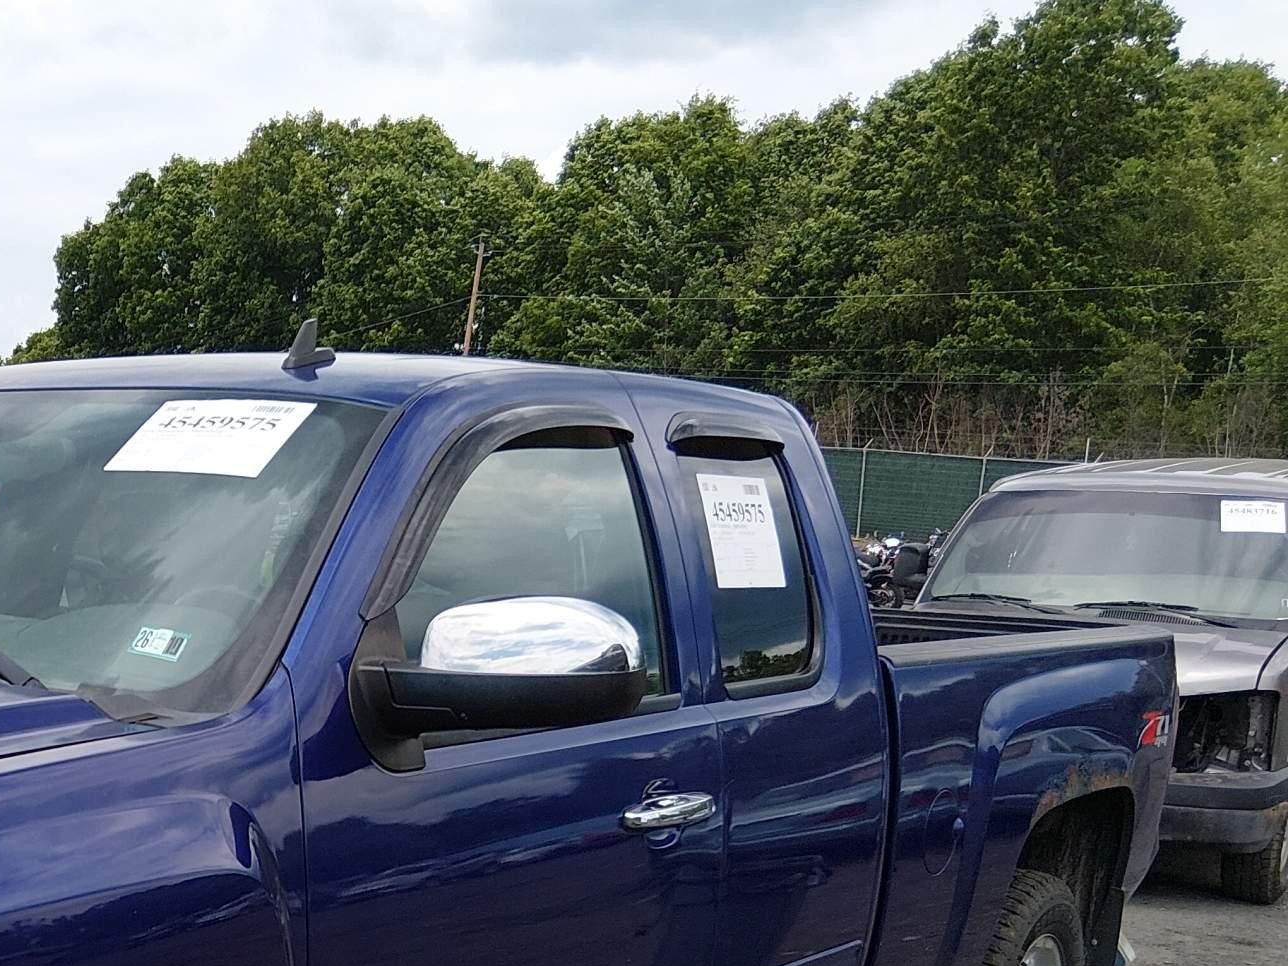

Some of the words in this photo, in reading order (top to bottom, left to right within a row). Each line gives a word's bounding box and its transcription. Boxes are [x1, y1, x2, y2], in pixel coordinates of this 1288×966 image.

[158, 415, 281, 432] 45459575
[711, 500, 766, 524] 45459575
[134, 630, 154, 649] 26
